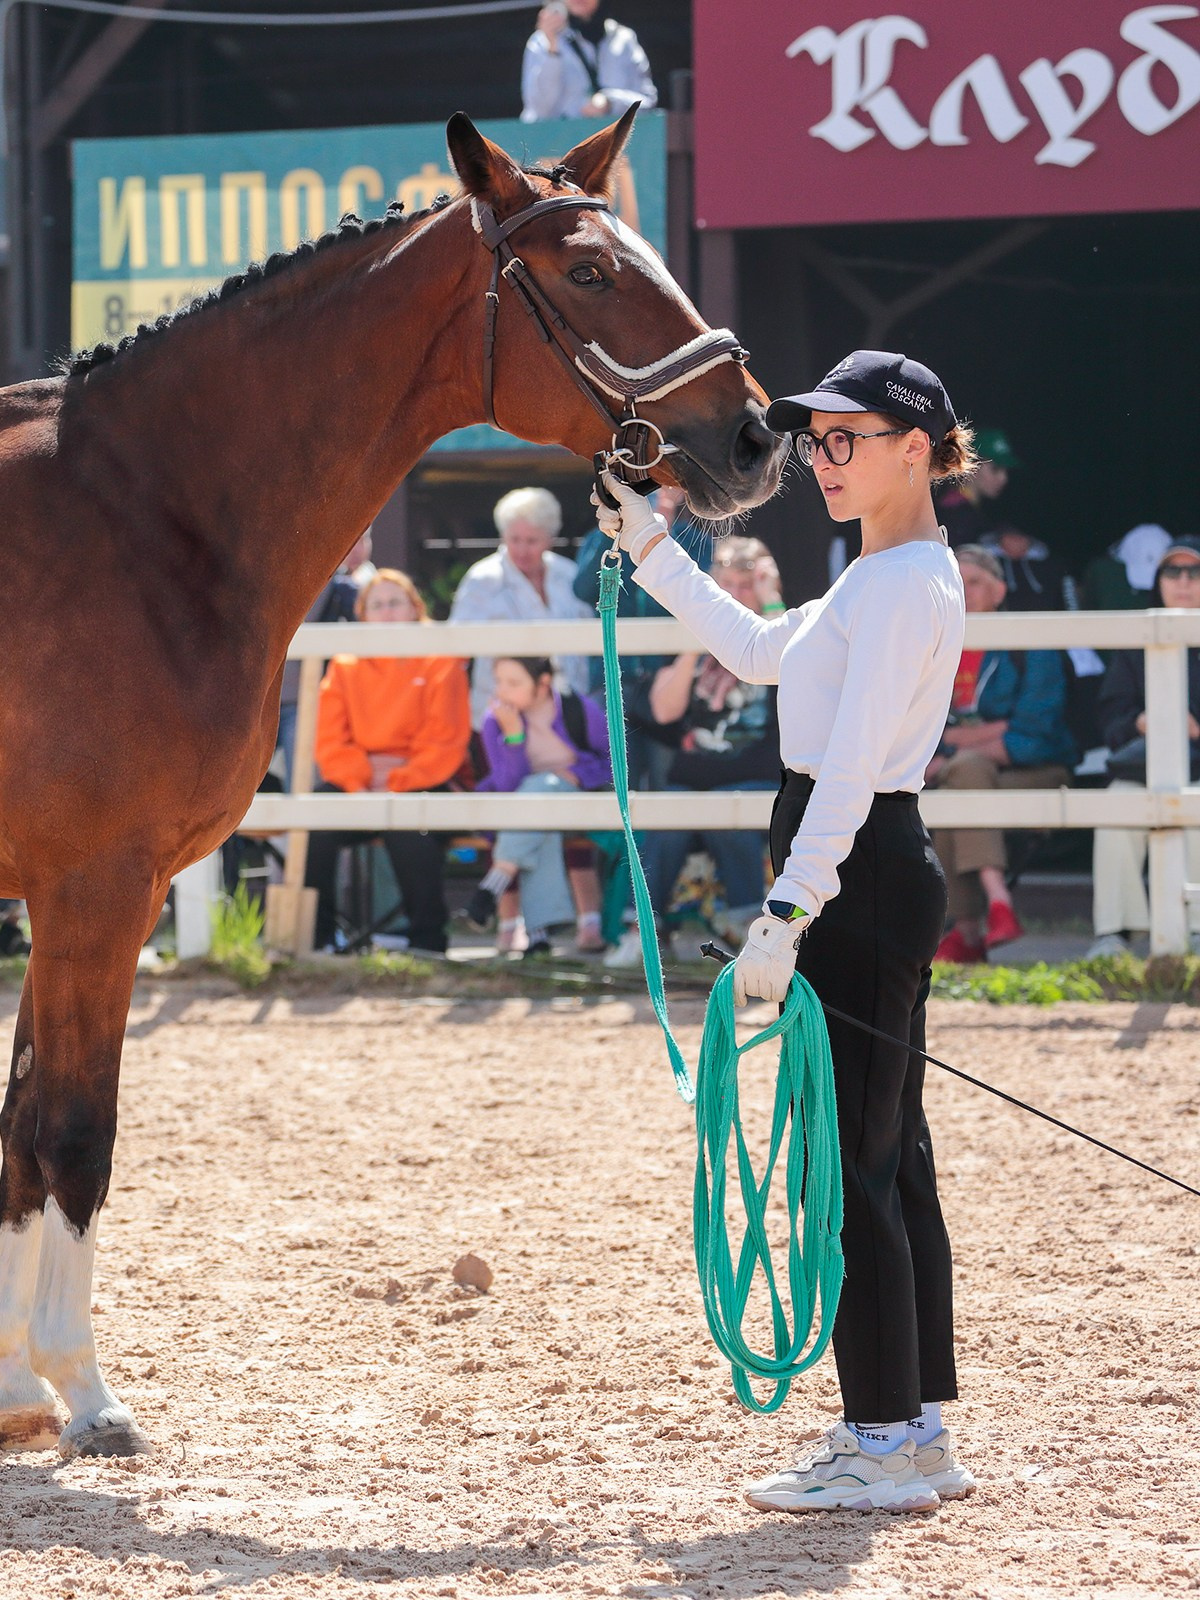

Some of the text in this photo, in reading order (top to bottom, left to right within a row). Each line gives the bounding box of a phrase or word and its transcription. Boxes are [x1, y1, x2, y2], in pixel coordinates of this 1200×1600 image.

[786, 4, 1200, 168] Клуб
[886, 380, 934, 410] CAVALLERIA
[887, 389, 926, 413] TOSCANA
[855, 1429, 889, 1441] NIKE
